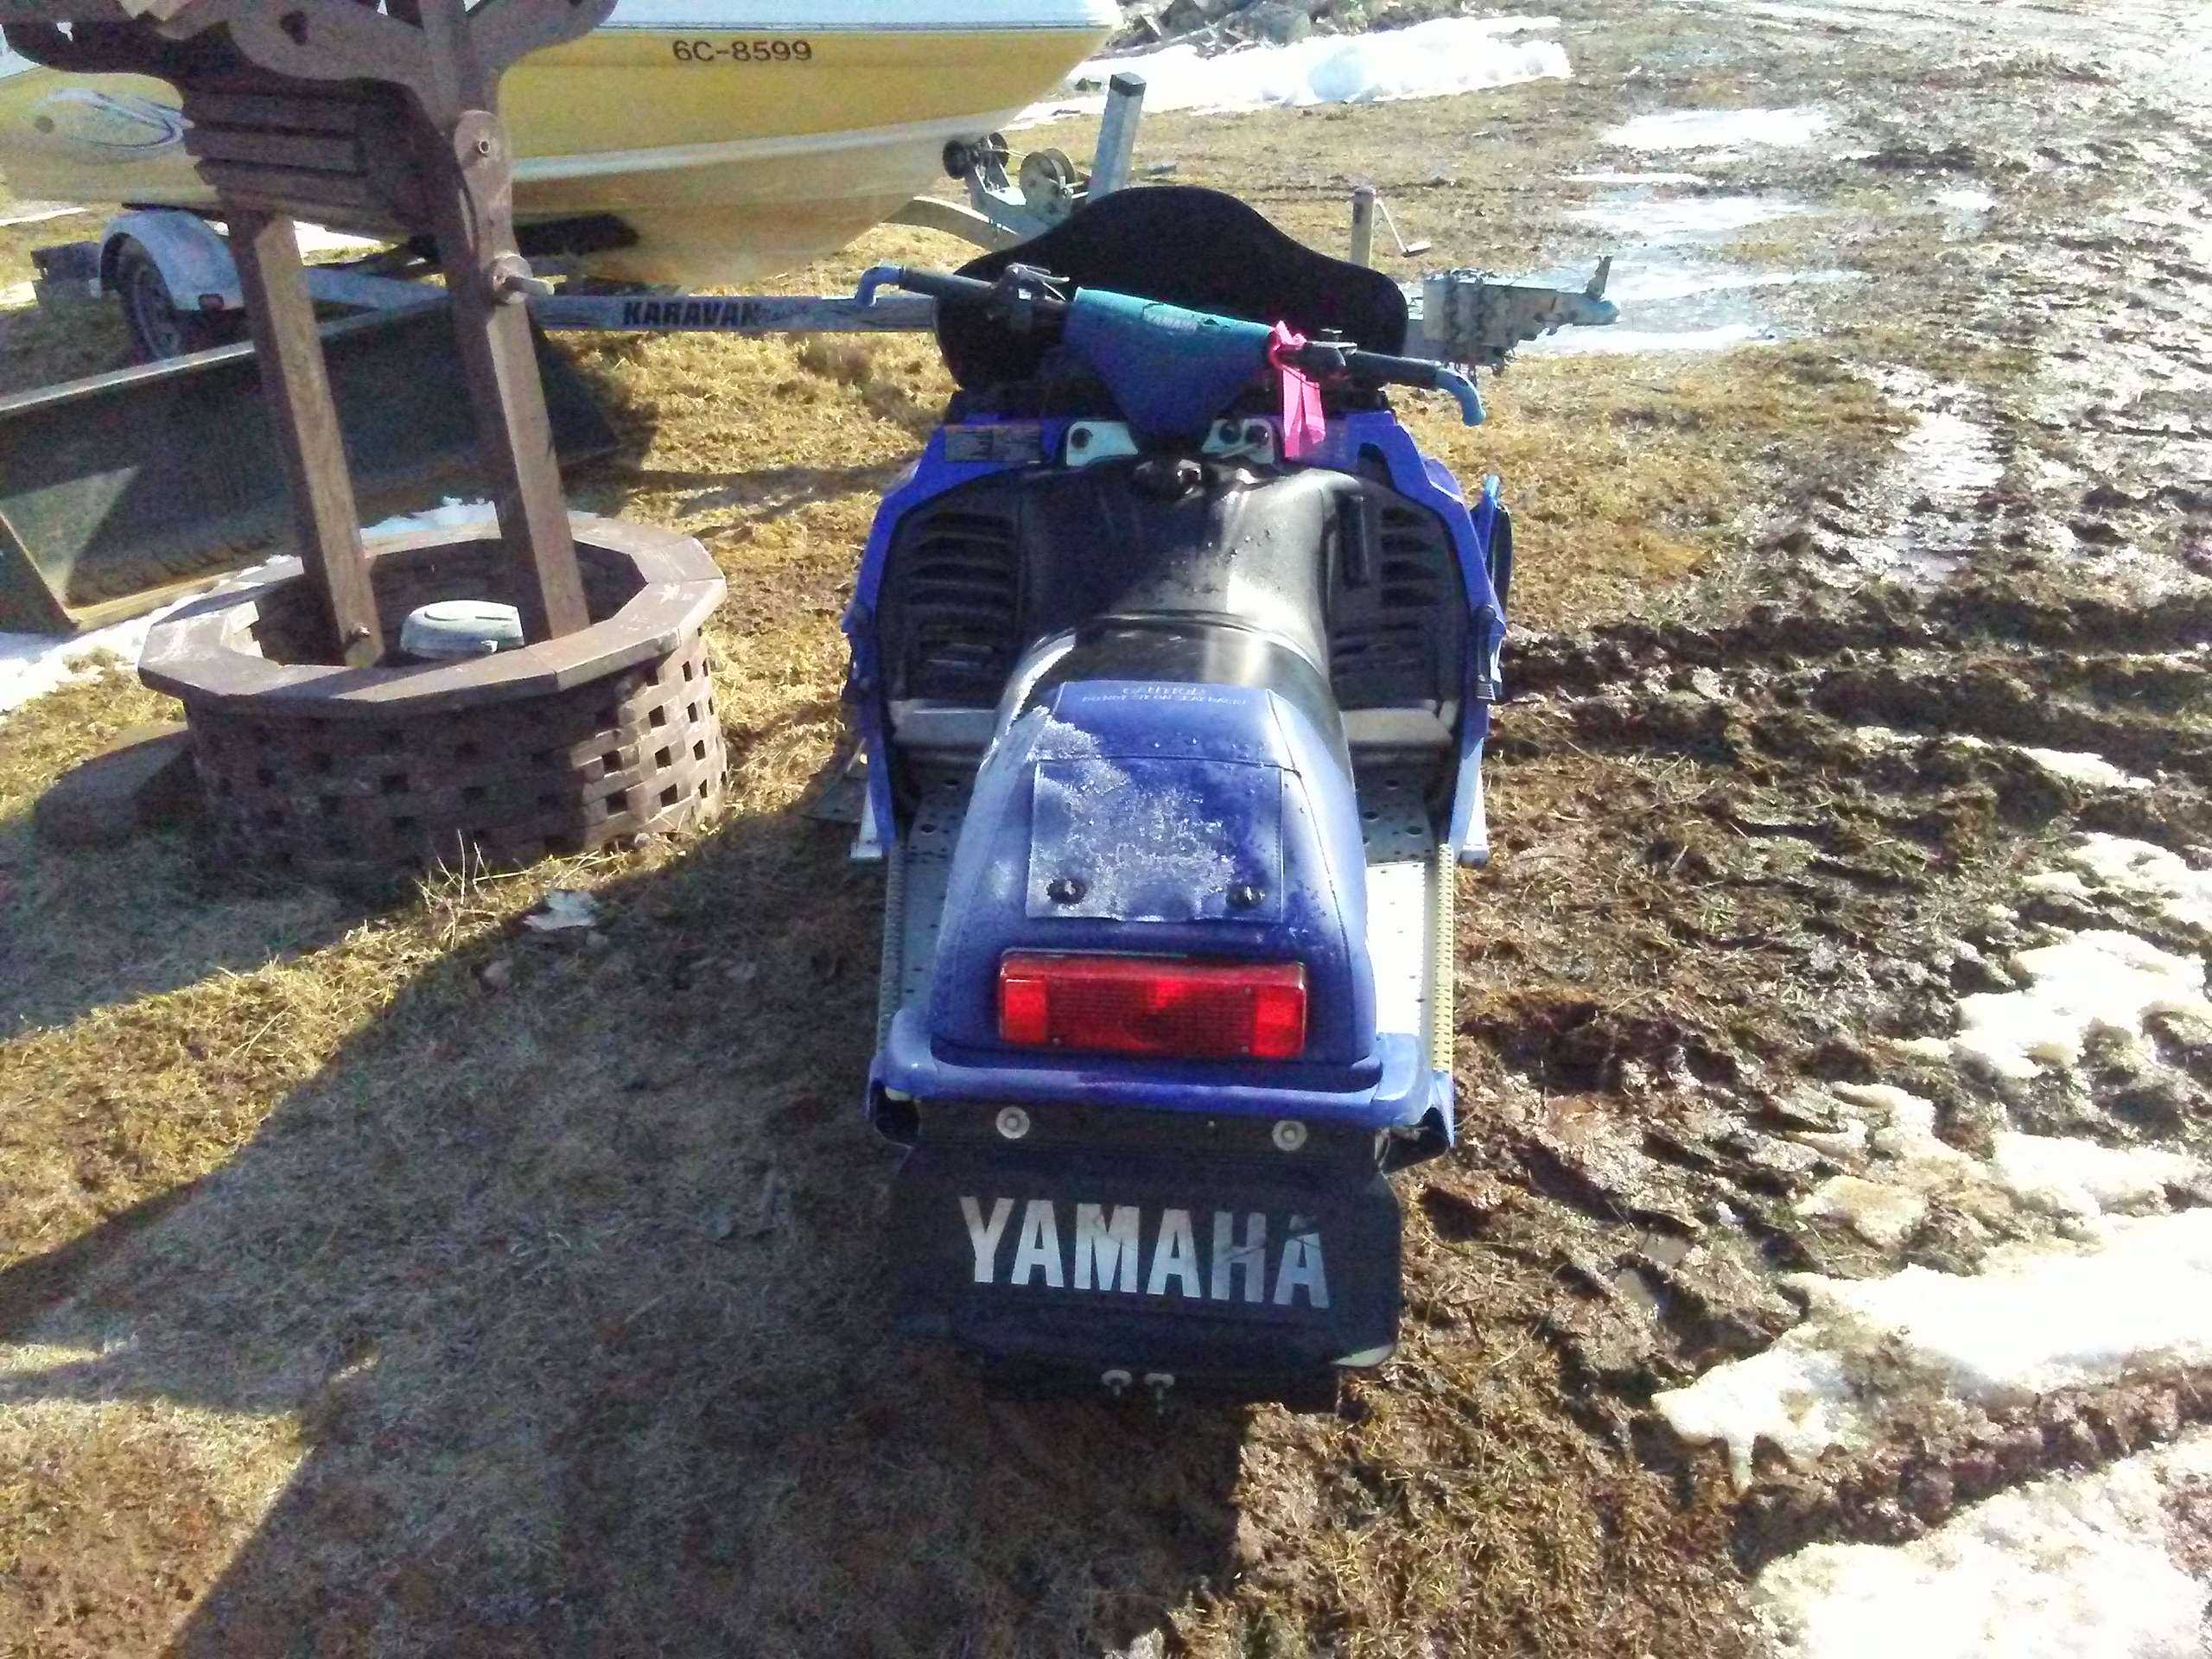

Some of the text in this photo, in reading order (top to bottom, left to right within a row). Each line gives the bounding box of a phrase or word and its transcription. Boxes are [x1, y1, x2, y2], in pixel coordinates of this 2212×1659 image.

[672, 40, 811, 61] 6C-8599
[622, 302, 760, 326] KARAVAN
[959, 1196, 1329, 1308] YAMAHA
